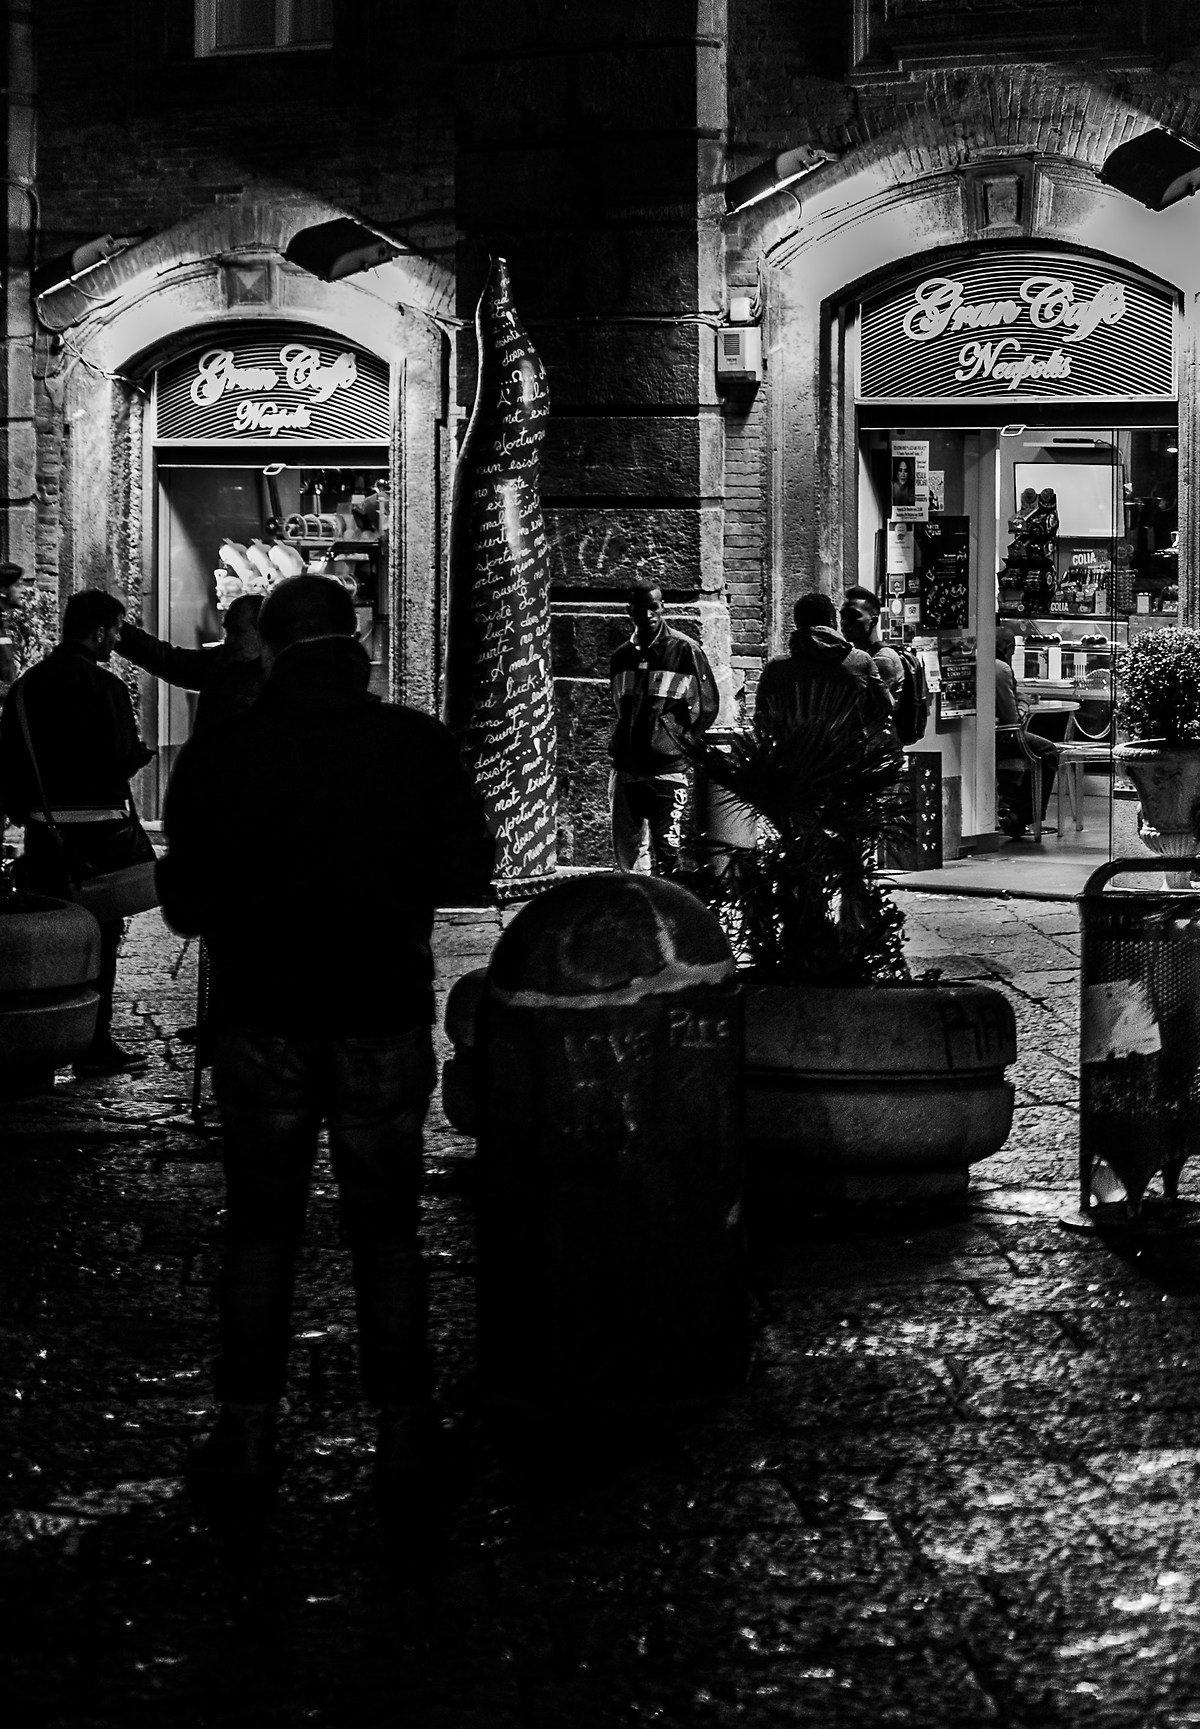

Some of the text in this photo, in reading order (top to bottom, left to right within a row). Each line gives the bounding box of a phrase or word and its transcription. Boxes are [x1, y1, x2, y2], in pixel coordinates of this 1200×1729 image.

[902, 277, 1021, 342] Gran
[190, 350, 280, 406] Gran
[955, 338, 1073, 391] Neapolis
